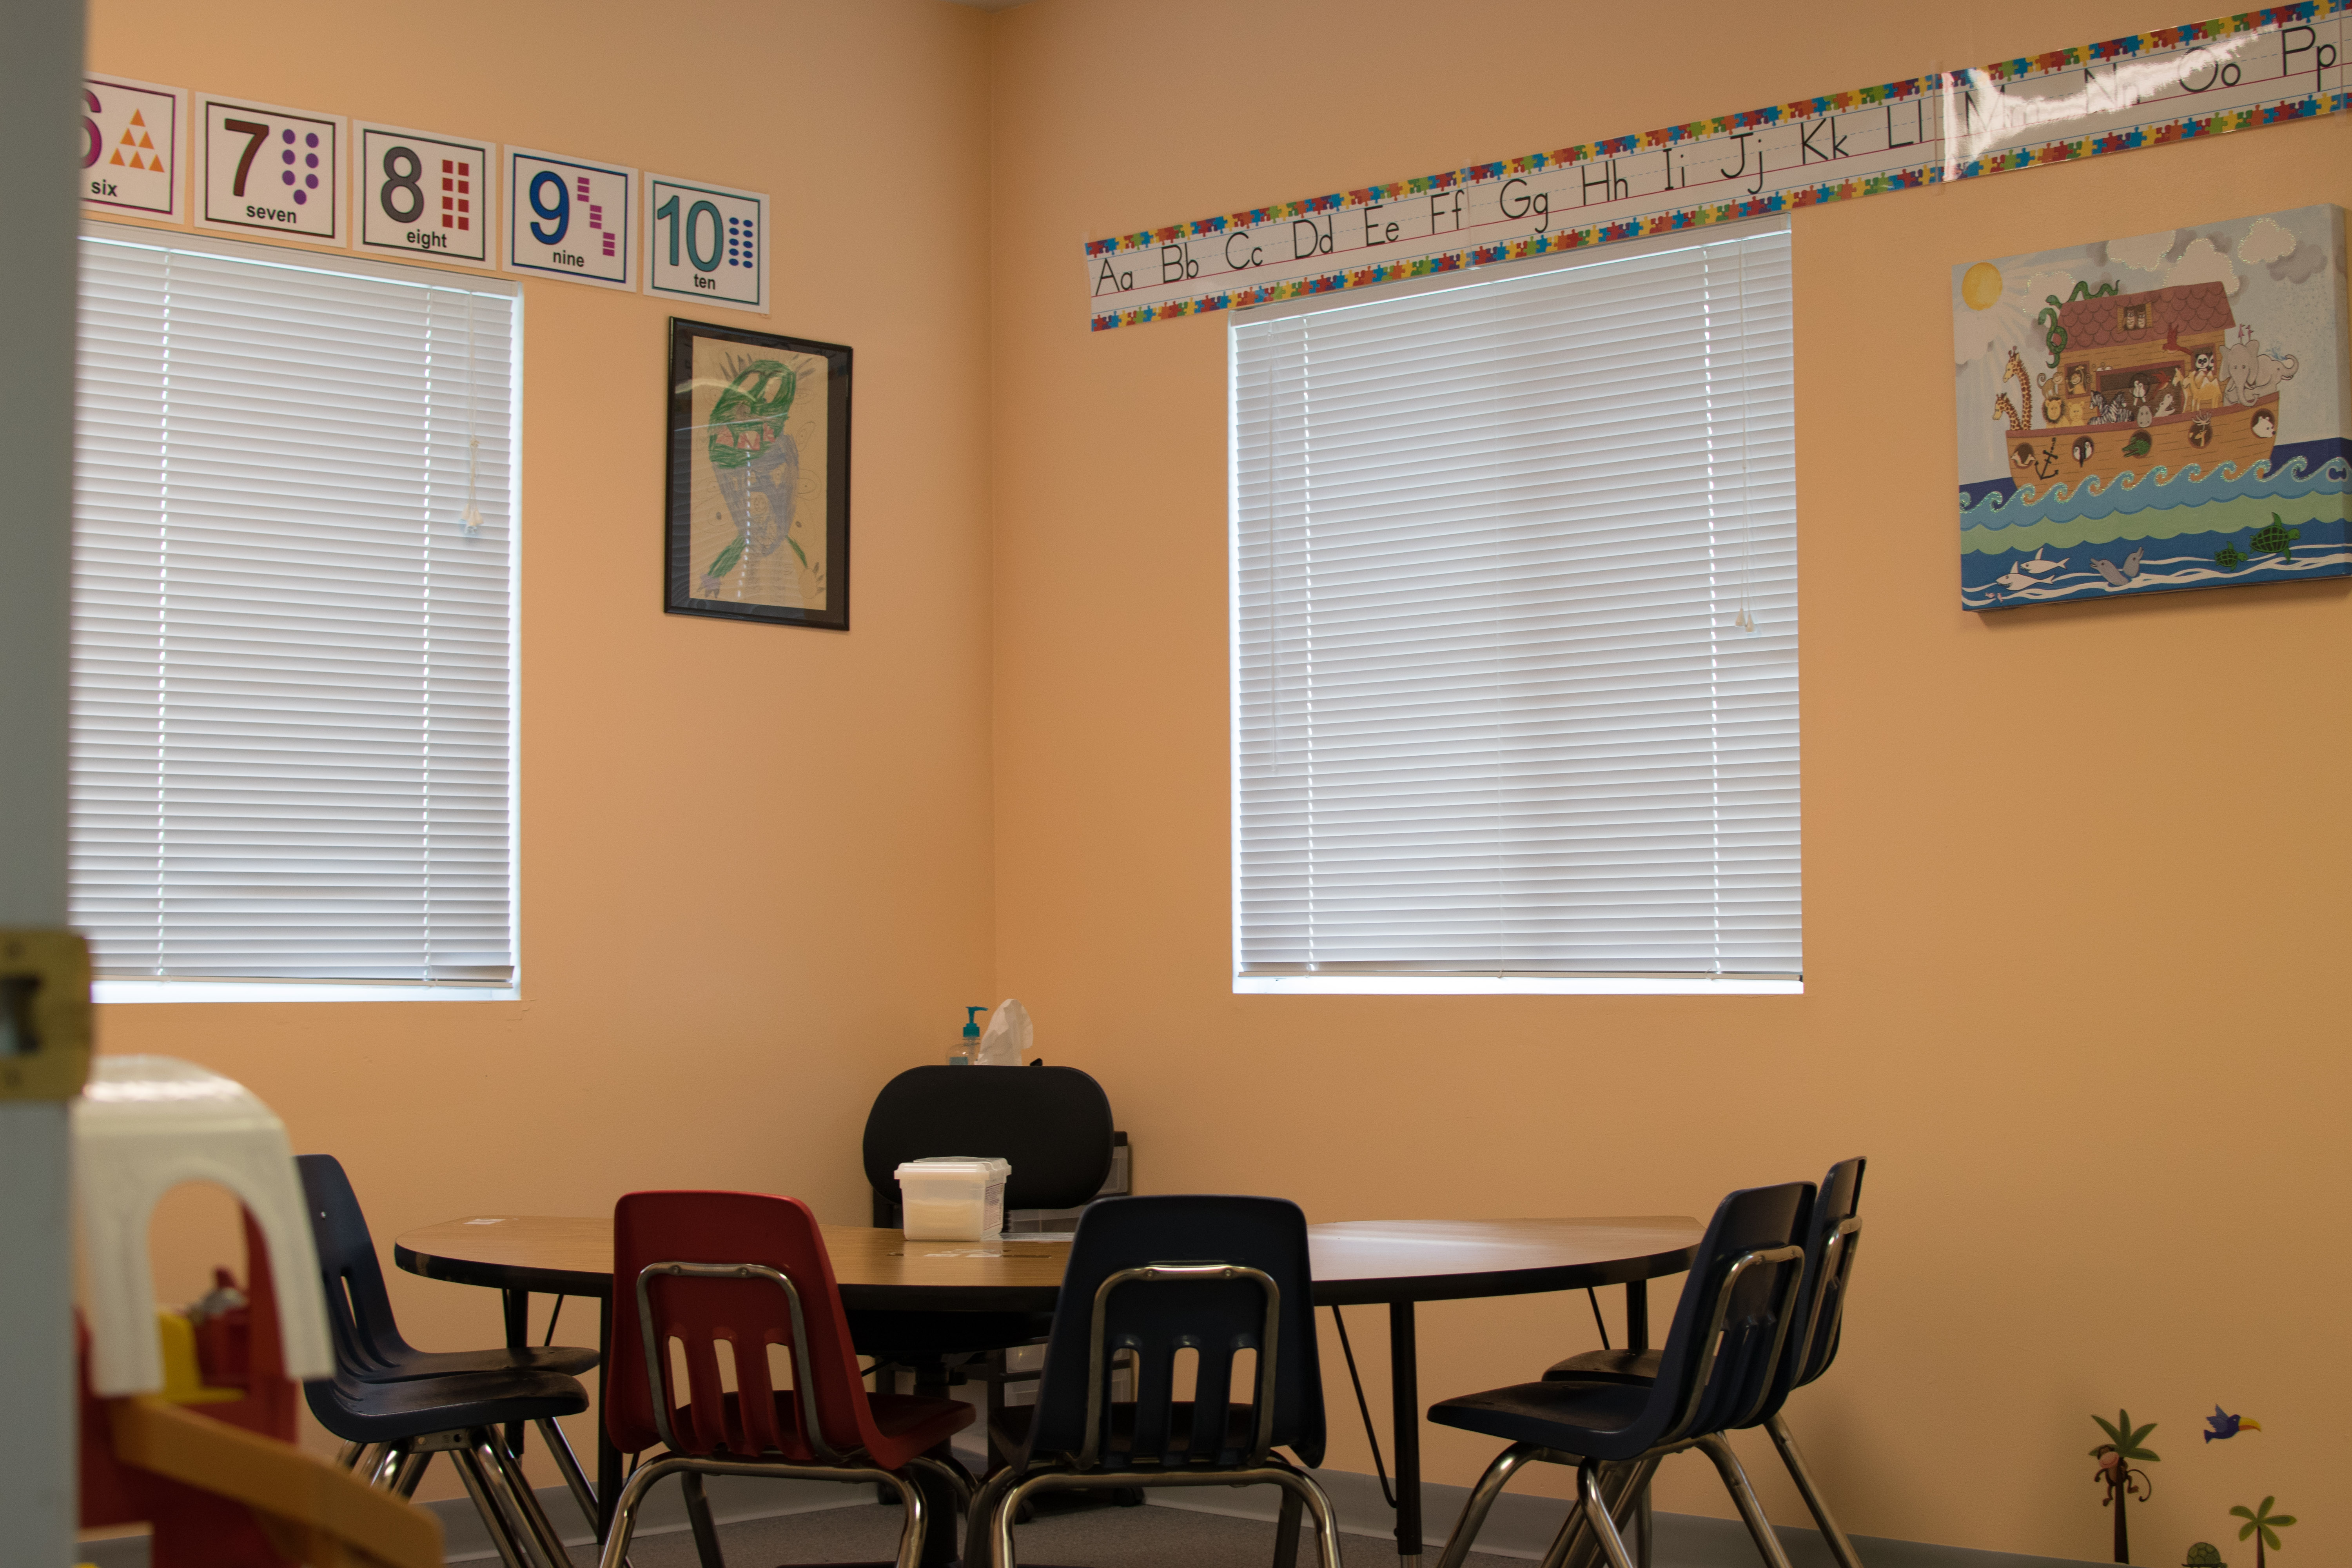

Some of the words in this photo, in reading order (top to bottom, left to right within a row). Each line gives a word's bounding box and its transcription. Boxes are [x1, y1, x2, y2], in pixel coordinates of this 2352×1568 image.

[225, 118, 269, 197] 7
[1096, 258, 1132, 296] Aa
[1161, 242, 1199, 283] Bb
[1225, 232, 1263, 270] Cc
[1294, 214, 1333, 259] Dd
[1365, 205, 1399, 246] Ee
[1431, 190, 1464, 234] Ff
[1500, 178, 1548, 233] Gg
[1582, 159, 1628, 206] Hh
[1663, 148, 1685, 190] Ii
[1721, 132, 1763, 194] Jj
[1801, 116, 1849, 165] Kk
[1887, 100, 1922, 149] Ll
[2178, 47, 2241, 93] Oo
[2281, 26, 2336, 92] Pp
[91, 179, 117, 196] six
[380, 146, 424, 223] 8
[529, 171, 569, 245] 9
[247, 205, 296, 223] seven
[657, 195, 723, 272] 10
[407, 229, 446, 250] eight
[552, 250, 584, 267] nine
[693, 274, 716, 290] ten
